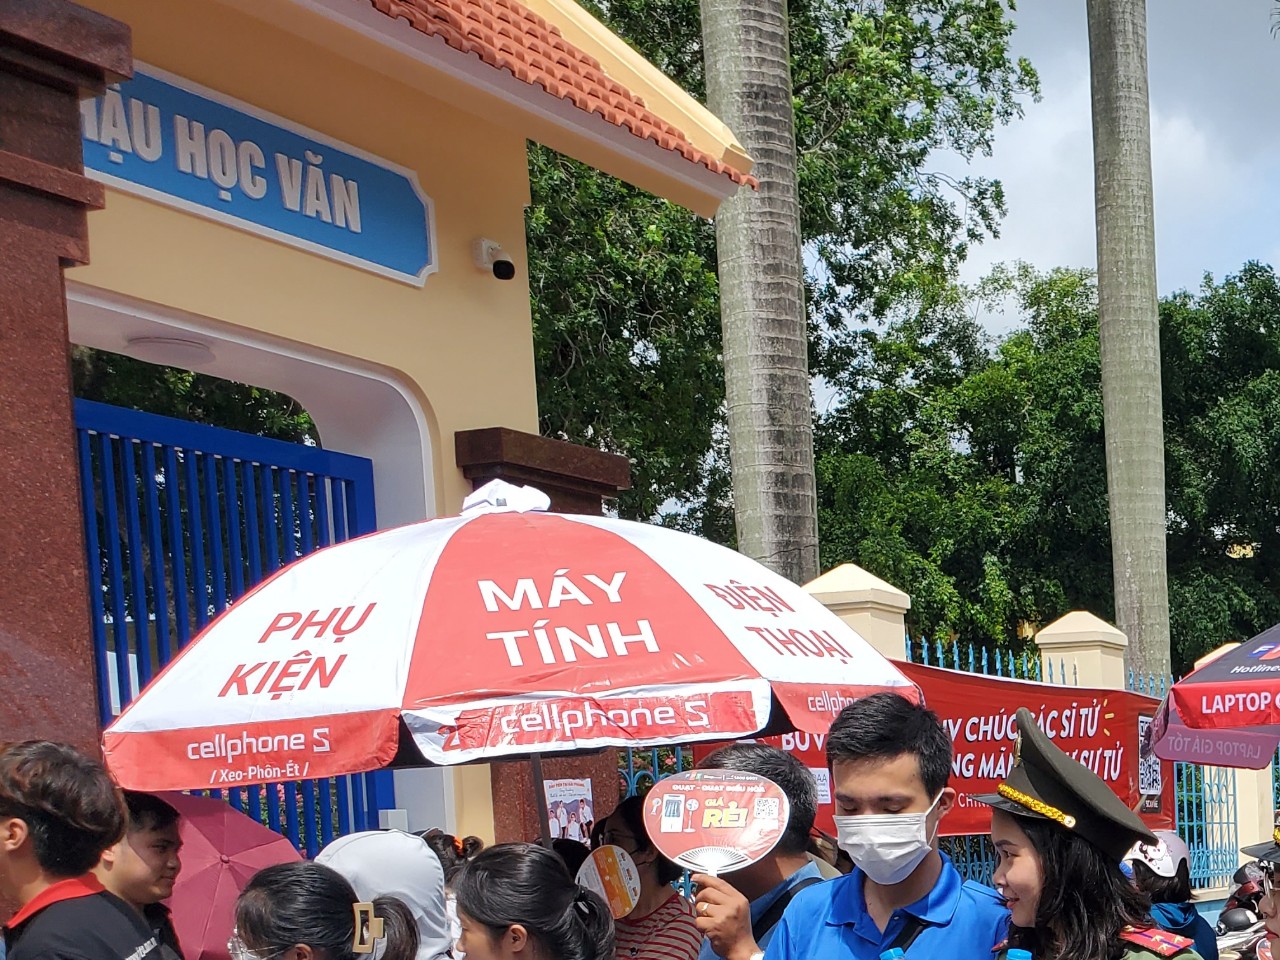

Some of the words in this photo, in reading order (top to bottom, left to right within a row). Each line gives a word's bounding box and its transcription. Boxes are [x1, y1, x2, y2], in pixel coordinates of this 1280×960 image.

[173, 114, 267, 201] HỌC
[275, 150, 361, 233] VĂN
[477, 568, 627, 612] MÁY
[704, 579, 796, 617] ĐIỆN
[258, 602, 377, 643] PHỤ
[486, 619, 660, 667] TÍNH
[744, 626, 853, 664] THOẠI
[218, 650, 347, 700] KIỆN
[1079, 699, 1100, 733] TỬ
[1202, 690, 1271, 715] LAPTOP
[219, 760, 300, 782] Xeo-Phôn-Ét
[1103, 740, 1123, 781] TỬ
